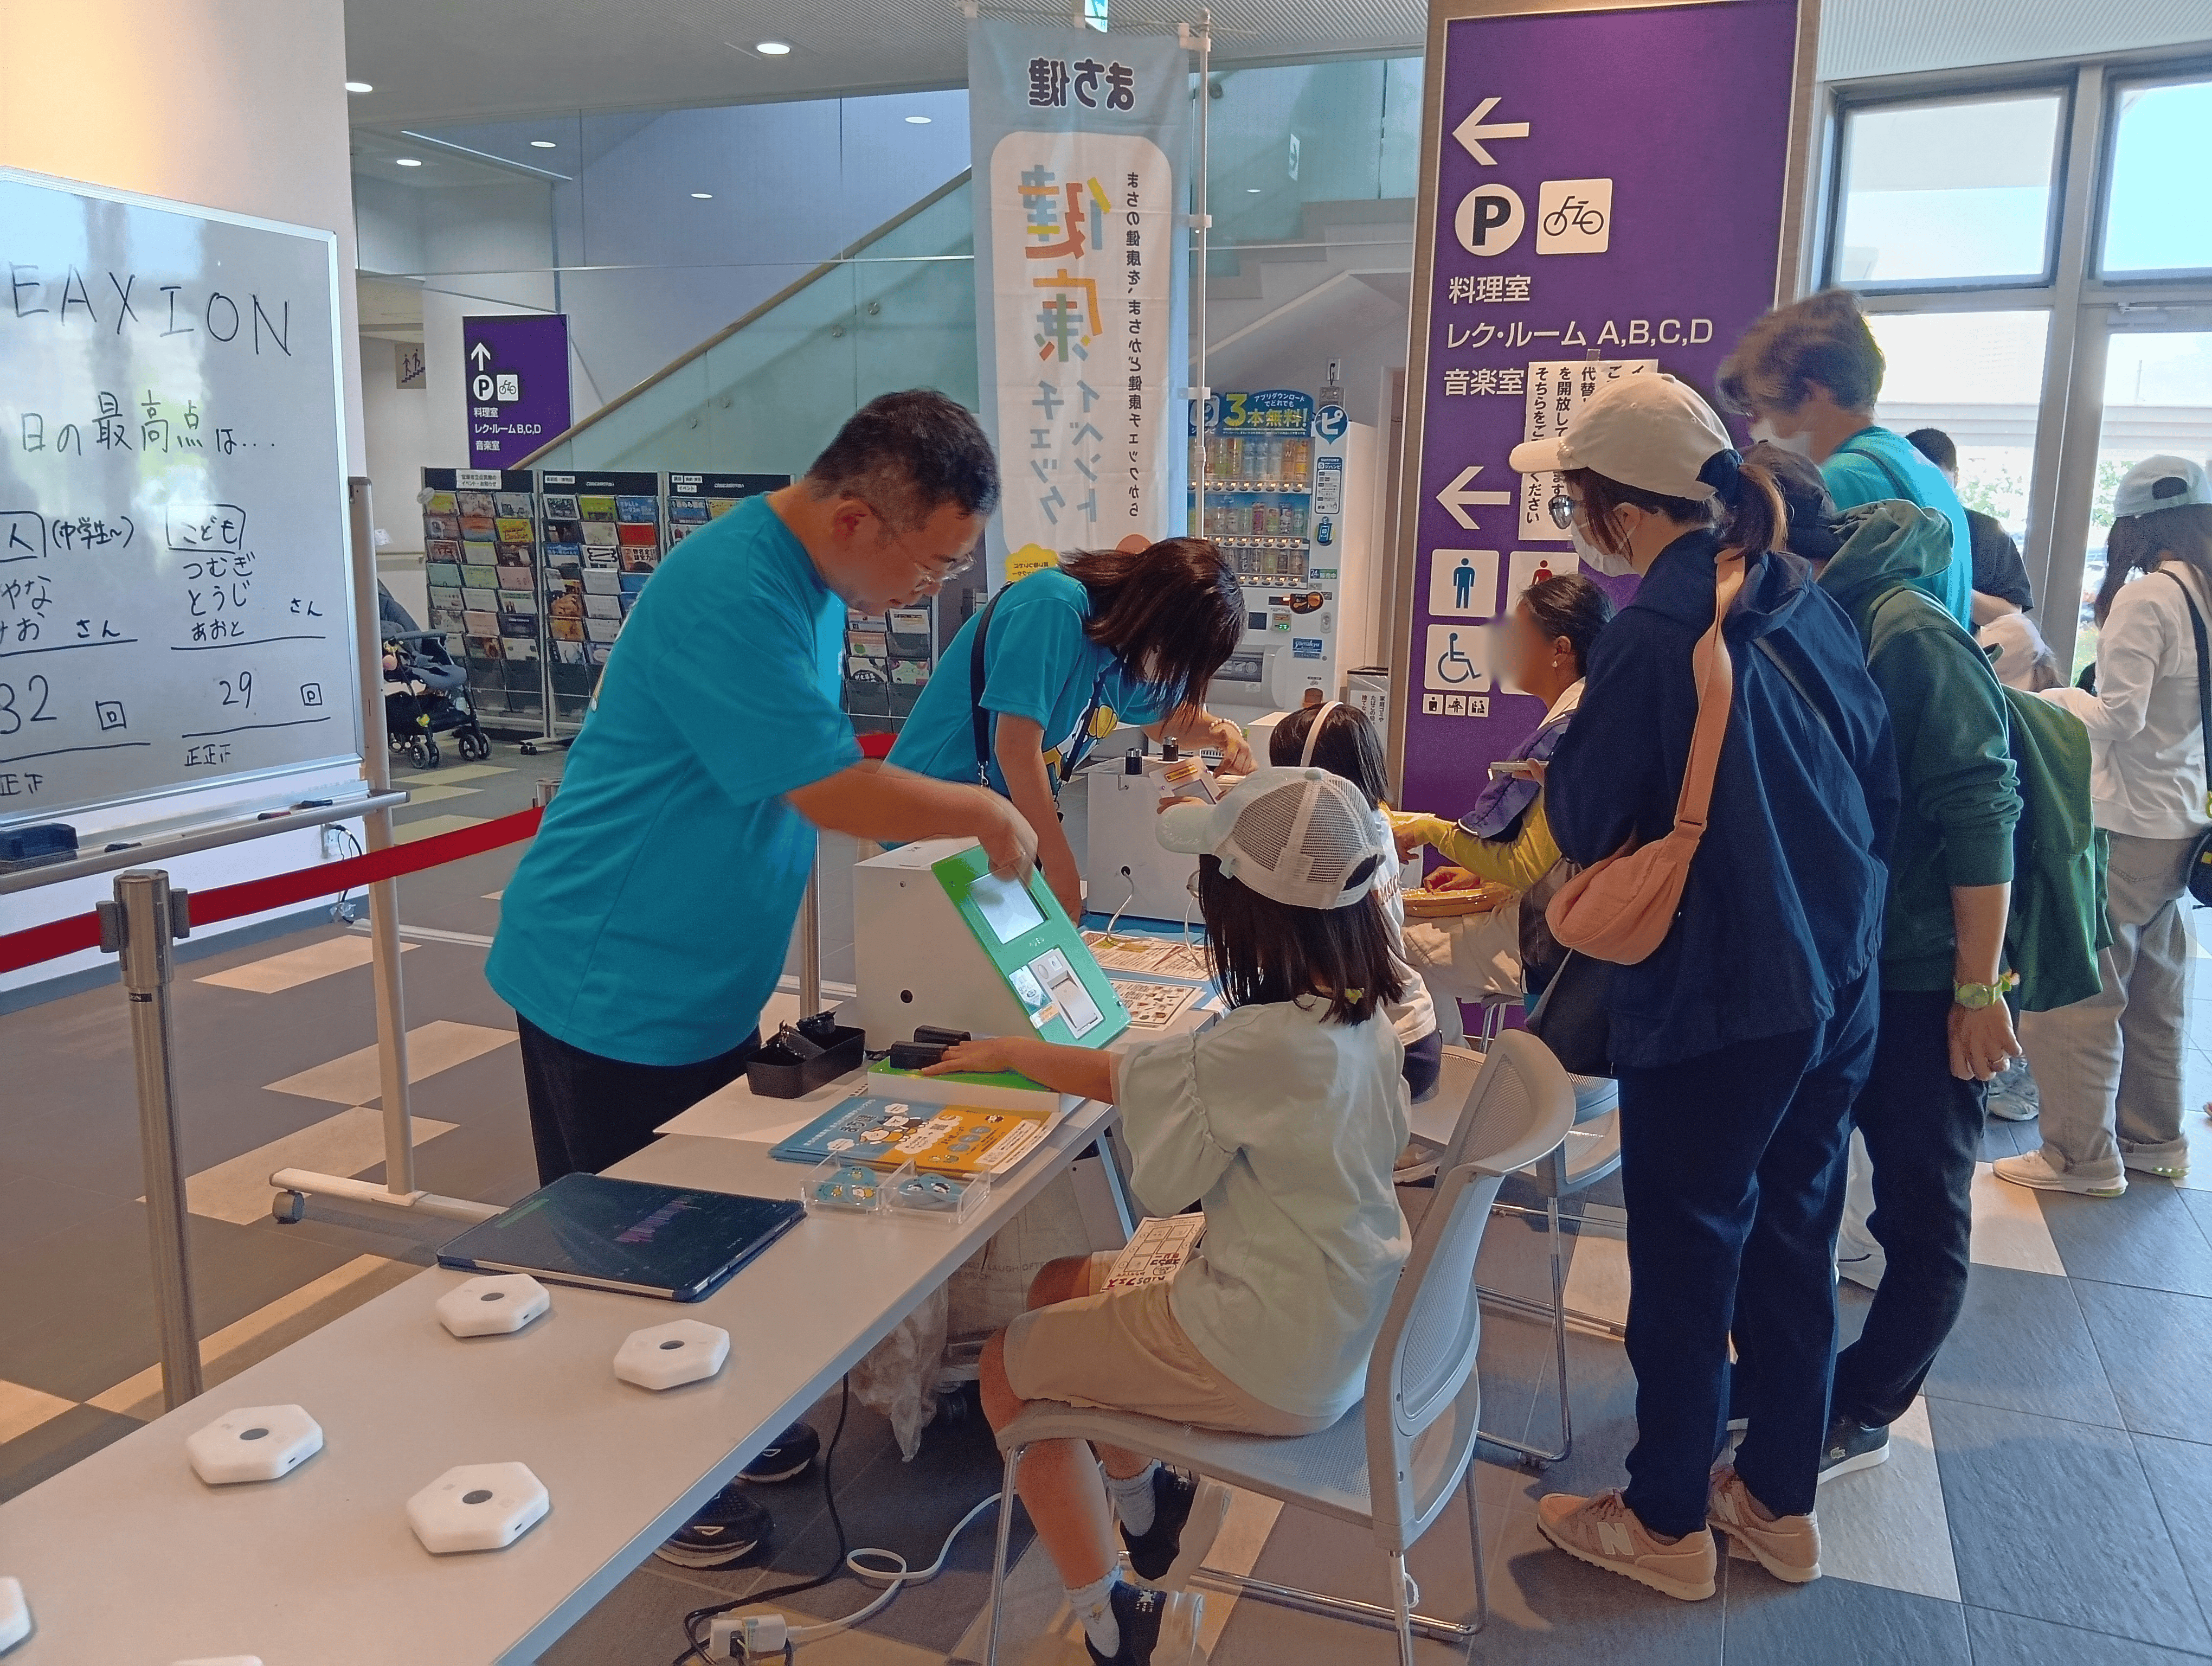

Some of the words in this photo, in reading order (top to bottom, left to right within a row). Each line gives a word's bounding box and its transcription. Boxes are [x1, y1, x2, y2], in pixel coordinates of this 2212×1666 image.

[1471, 195, 1512, 246] P
[1448, 275, 1531, 304] 料理室
[1446, 321, 1586, 349] レク・ルーム
[1597, 319, 1713, 347] A,B,C,D
[479, 379, 489, 397] P
[1444, 368, 1524, 396] 音楽室
[1580, 367, 1596, 402] 代替
[1254, 392, 1305, 402] アプリダウンロード
[474, 407, 499, 418] 料理室
[1321, 409, 1343, 435] ピ
[475, 440, 500, 451] 音楽室
[181, 515, 237, 544] こども
[183, 551, 255, 580] つむぎ
[188, 580, 250, 616] とうじ
[76, 619, 121, 639] さん
[191, 618, 245, 641] あおと
[290, 598, 323, 617] さん
[0, 674, 57, 735] 32
[95, 700, 127, 731] 回
[219, 671, 252, 709] 29
[300, 682, 323, 706] 回
